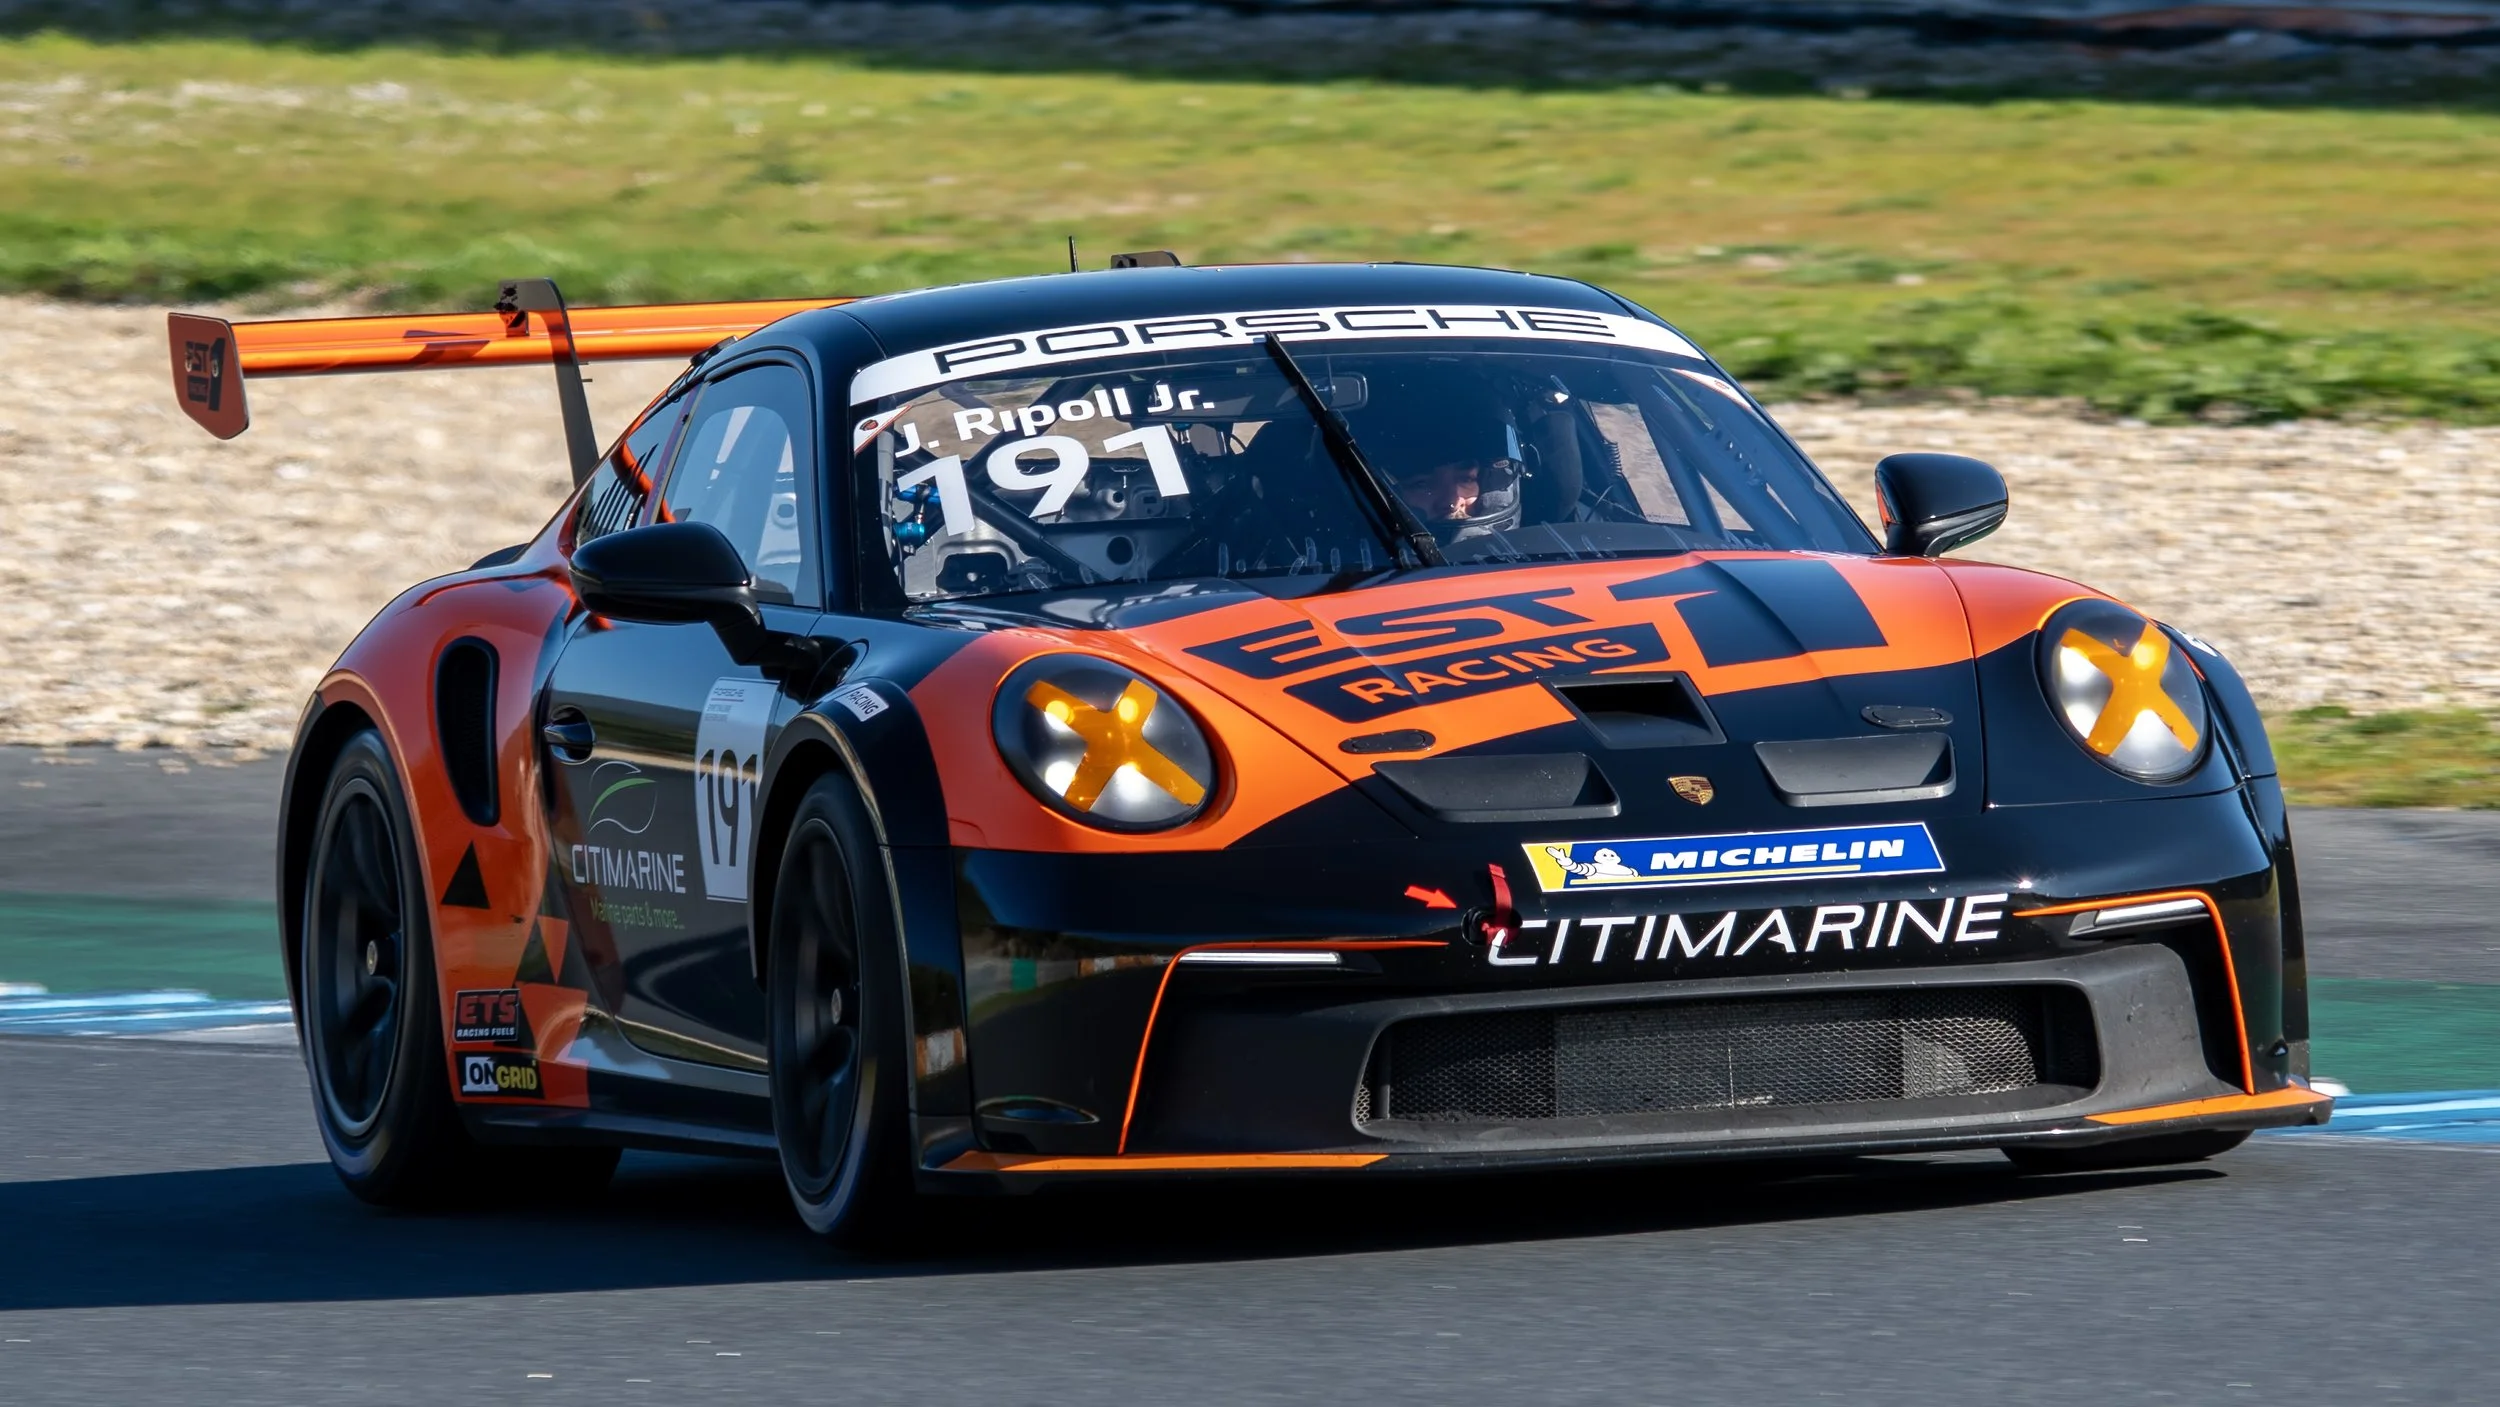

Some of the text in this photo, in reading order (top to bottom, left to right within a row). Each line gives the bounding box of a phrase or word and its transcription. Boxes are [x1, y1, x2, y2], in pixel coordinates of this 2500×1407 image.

[932, 308, 1616, 374] PORSCHE
[894, 383, 1215, 458] J. Ripoll Jr.
[897, 424, 1190, 536] 191
[1340, 638, 1638, 704] RACING
[847, 690, 879, 715] RACING
[571, 844, 686, 894] CITIMARINE
[1650, 839, 1905, 870] MICHELIN
[589, 896, 621, 924] Marine
[1488, 893, 2008, 966] CITIMARINE
[456, 1027, 515, 1038] RACING FUELS
[459, 993, 517, 1025] ETS
